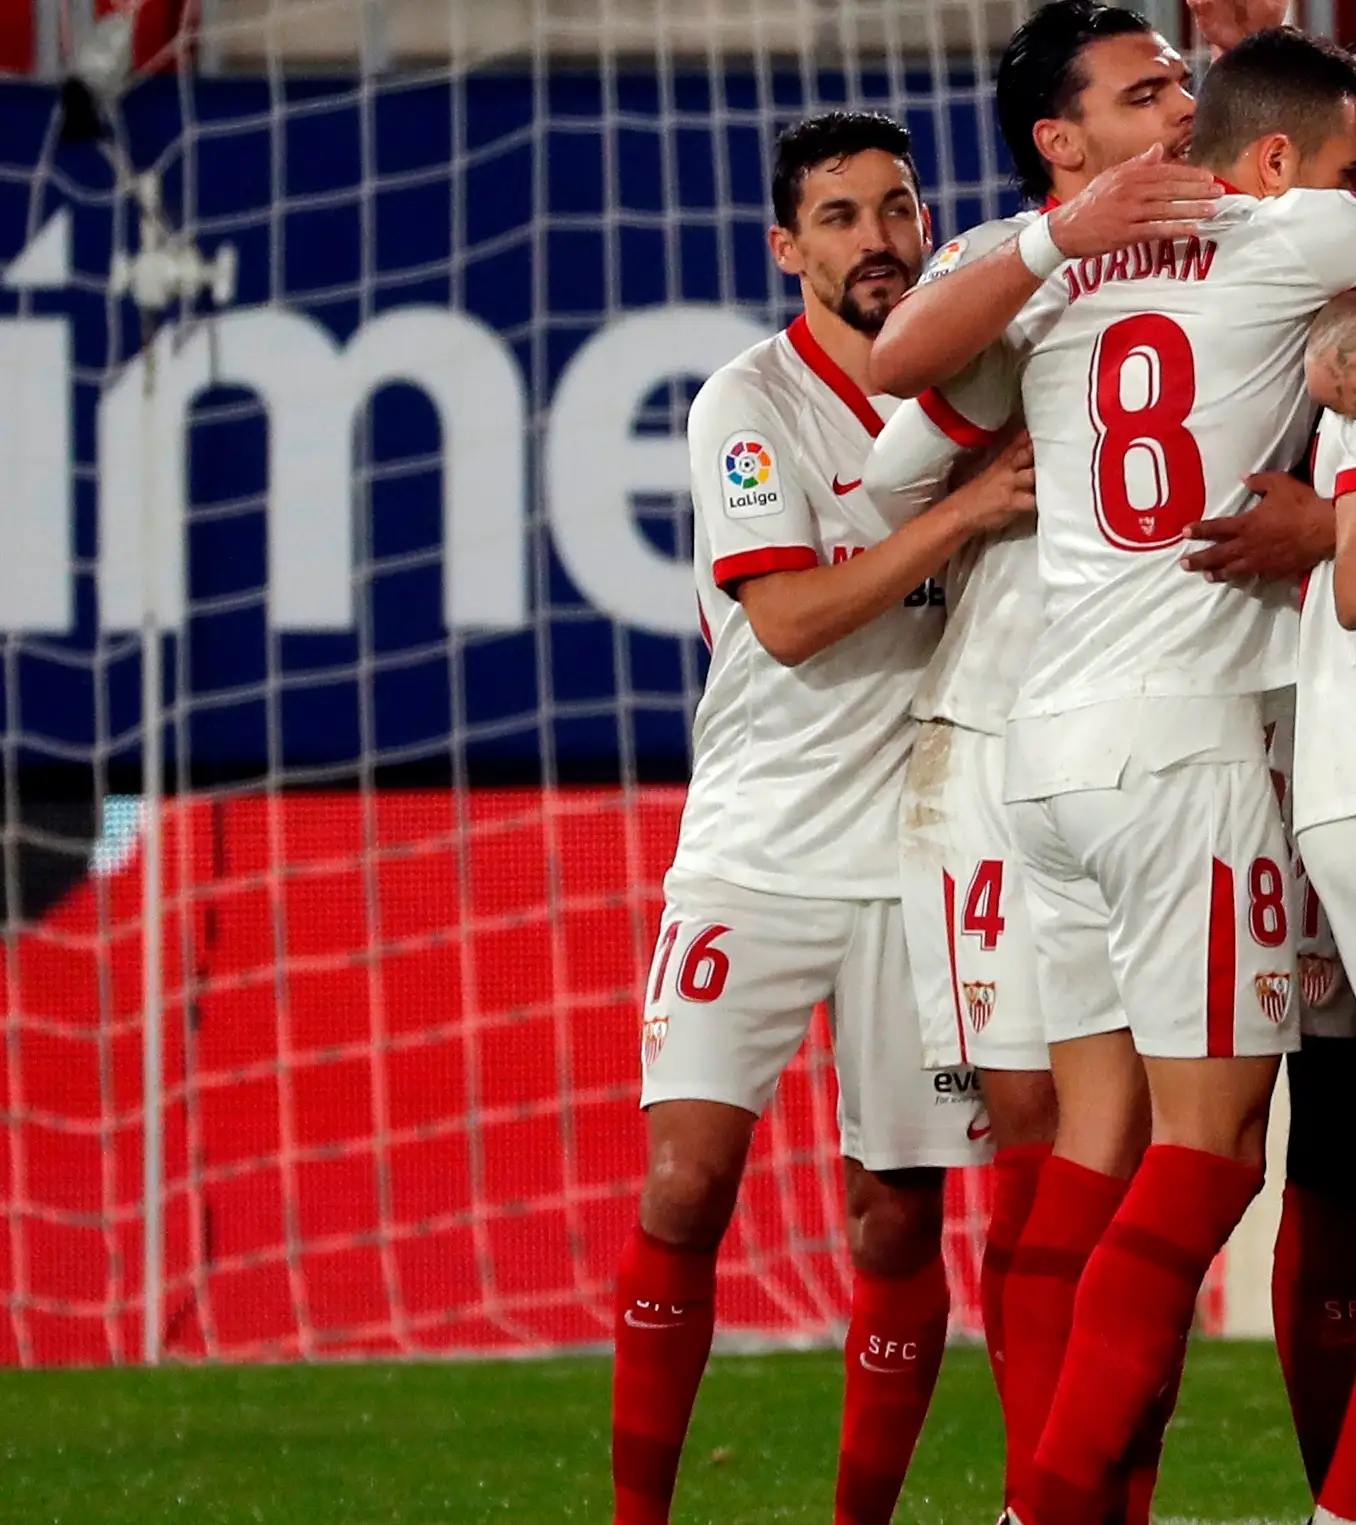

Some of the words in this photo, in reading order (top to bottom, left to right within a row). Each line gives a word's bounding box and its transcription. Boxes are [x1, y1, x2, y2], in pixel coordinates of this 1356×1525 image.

[1062, 235, 1217, 304] JORDAN
[1088, 313, 1206, 552] 8
[729, 491, 778, 508] LaLiga
[961, 859, 1004, 951] 4
[1247, 856, 1288, 948] 8
[651, 920, 733, 1003] 16
[868, 1334, 917, 1360] SFC
